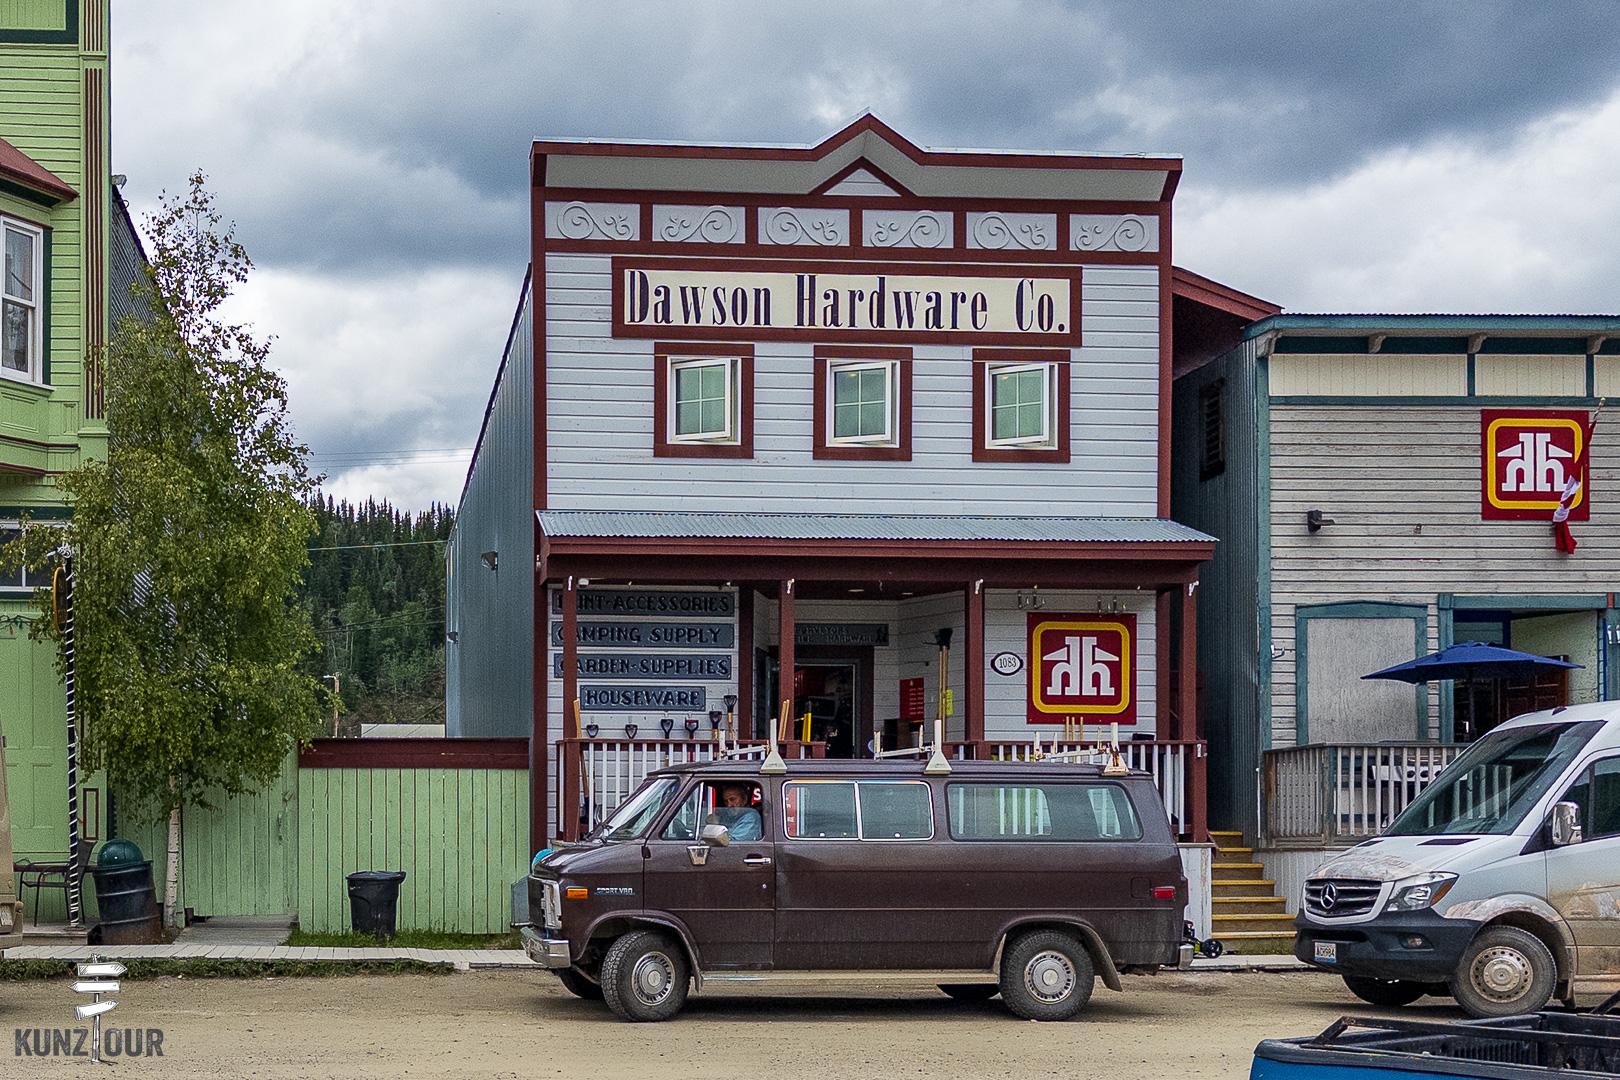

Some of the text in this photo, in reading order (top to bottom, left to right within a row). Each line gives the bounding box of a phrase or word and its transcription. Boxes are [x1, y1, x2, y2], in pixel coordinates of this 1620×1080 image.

[627, 269, 1066, 333] Dawson Hardware Co.
[648, 627, 721, 643] SUPPLY
[585, 689, 700, 706] HOUSEWARE
